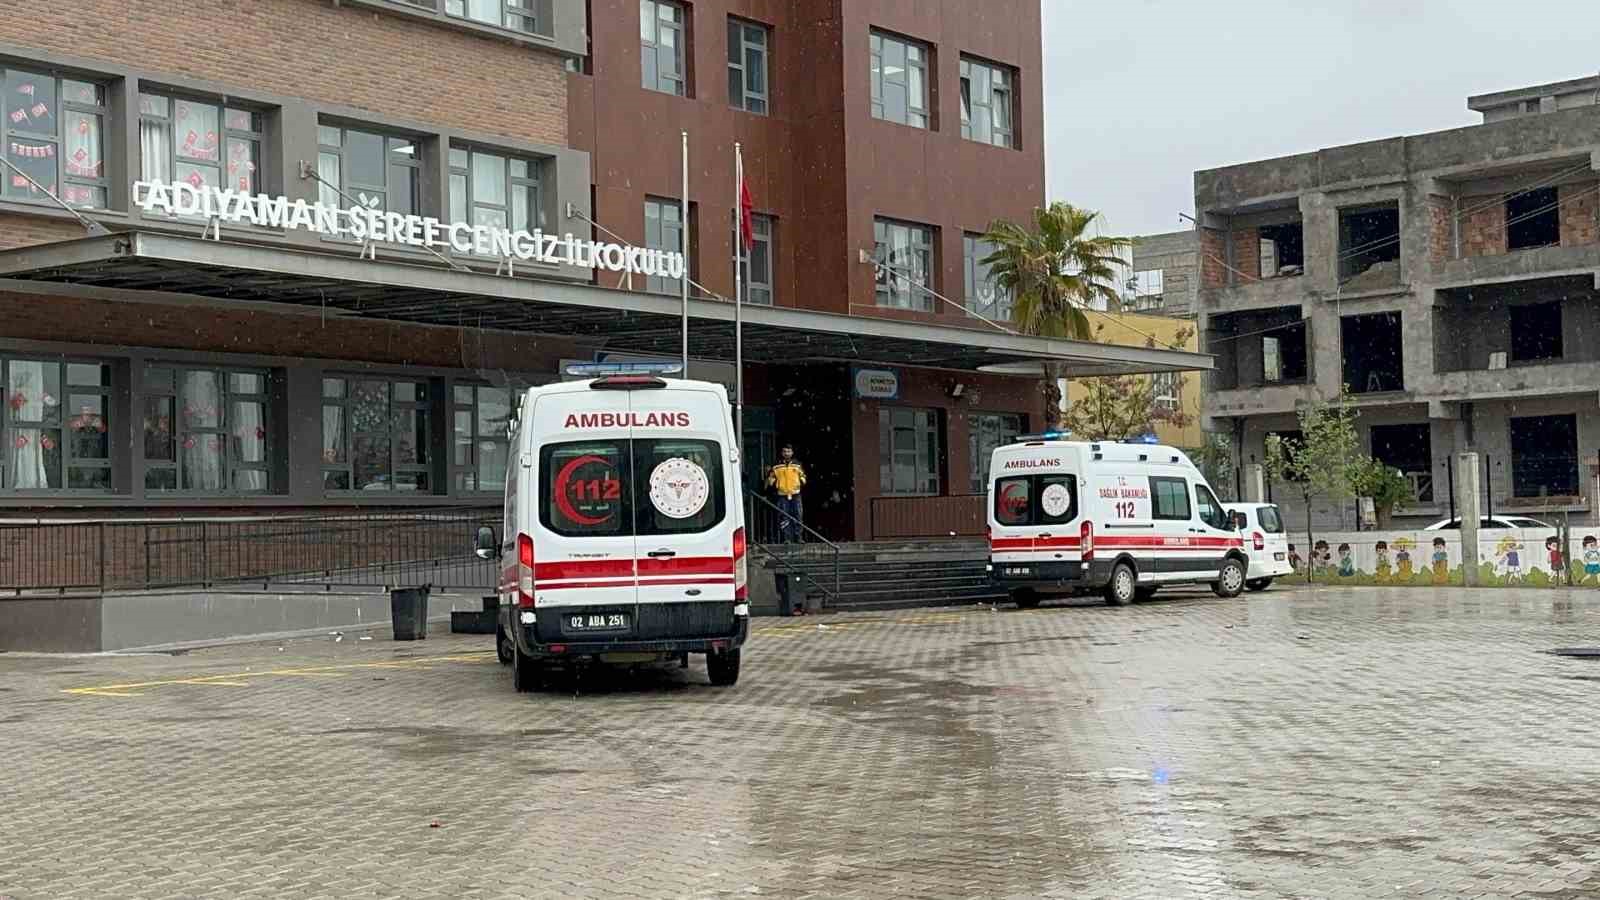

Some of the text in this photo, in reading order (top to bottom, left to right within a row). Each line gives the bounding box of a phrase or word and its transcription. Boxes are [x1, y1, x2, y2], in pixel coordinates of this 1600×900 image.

[142, 178, 684, 280] ADIYAMAN ŞEREF CENGİZ İLKOKULU
[564, 412, 690, 428] AMBULANS
[1004, 458, 1061, 469] AMBULANS
[571, 479, 620, 500] 112
[1115, 501, 1135, 519] 112
[571, 616, 583, 627] 02
[608, 614, 624, 626] 251
